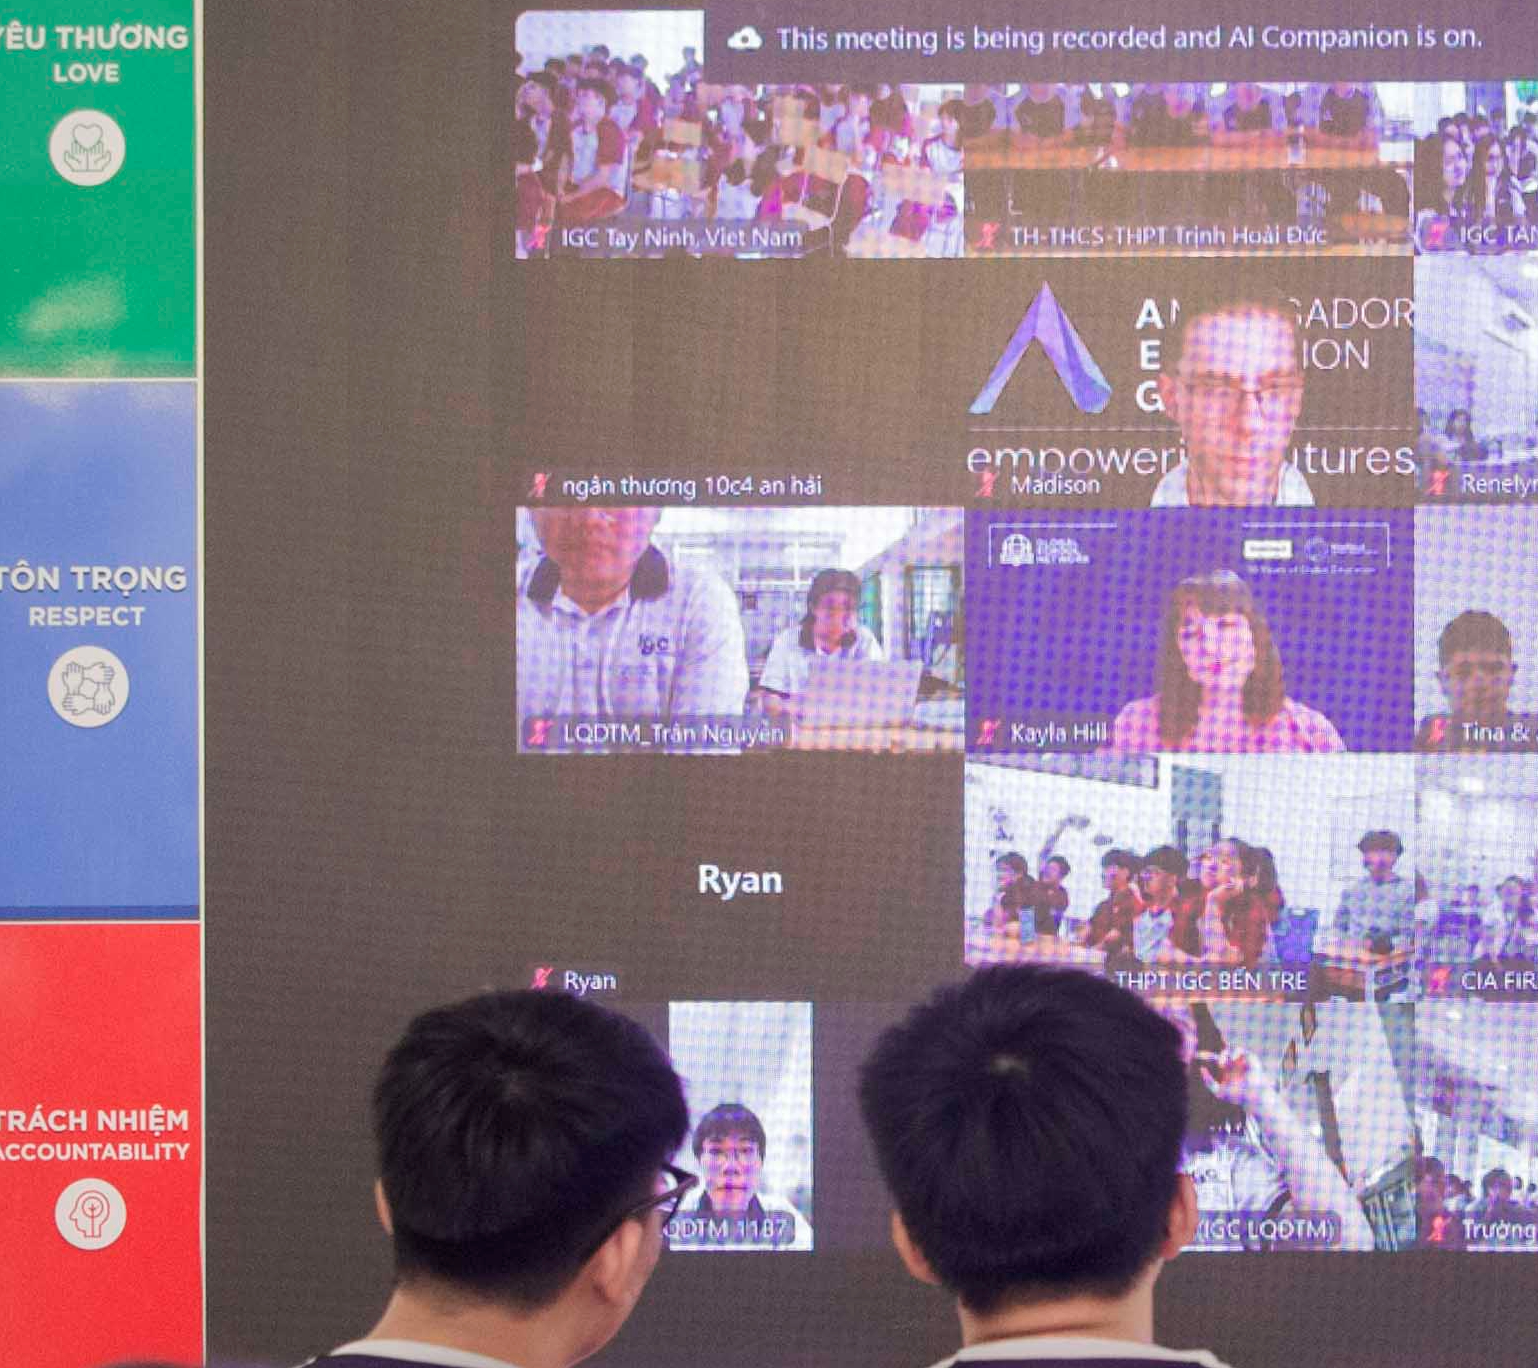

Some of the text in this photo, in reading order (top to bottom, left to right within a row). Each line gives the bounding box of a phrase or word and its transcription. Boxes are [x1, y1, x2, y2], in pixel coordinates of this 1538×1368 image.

[55, 22, 189, 51] THƯƠNG
[777, 24, 1483, 55] This meeting is being recorded and AI Companion is on.
[53, 62, 121, 84] LOVE
[562, 227, 599, 247] IGC
[752, 227, 803, 247] Nam
[1461, 224, 1498, 244] IGC
[705, 475, 754, 496] 10c4
[758, 479, 784, 496] an
[1012, 474, 1101, 495] Madison
[70, 565, 188, 599] TRỌNG
[29, 606, 146, 627] RESPECT
[1011, 720, 1108, 747] Kayla Hill
[1462, 721, 1504, 742] Tina
[1511, 723, 1530, 742] &
[698, 864, 784, 899] Ryan
[564, 969, 617, 994] Ryan
[1175, 970, 1213, 991] IGC
[1268, 970, 1308, 991] TRE
[1462, 971, 1498, 991] CIA
[97, 1103, 190, 1137] NHIỆM
